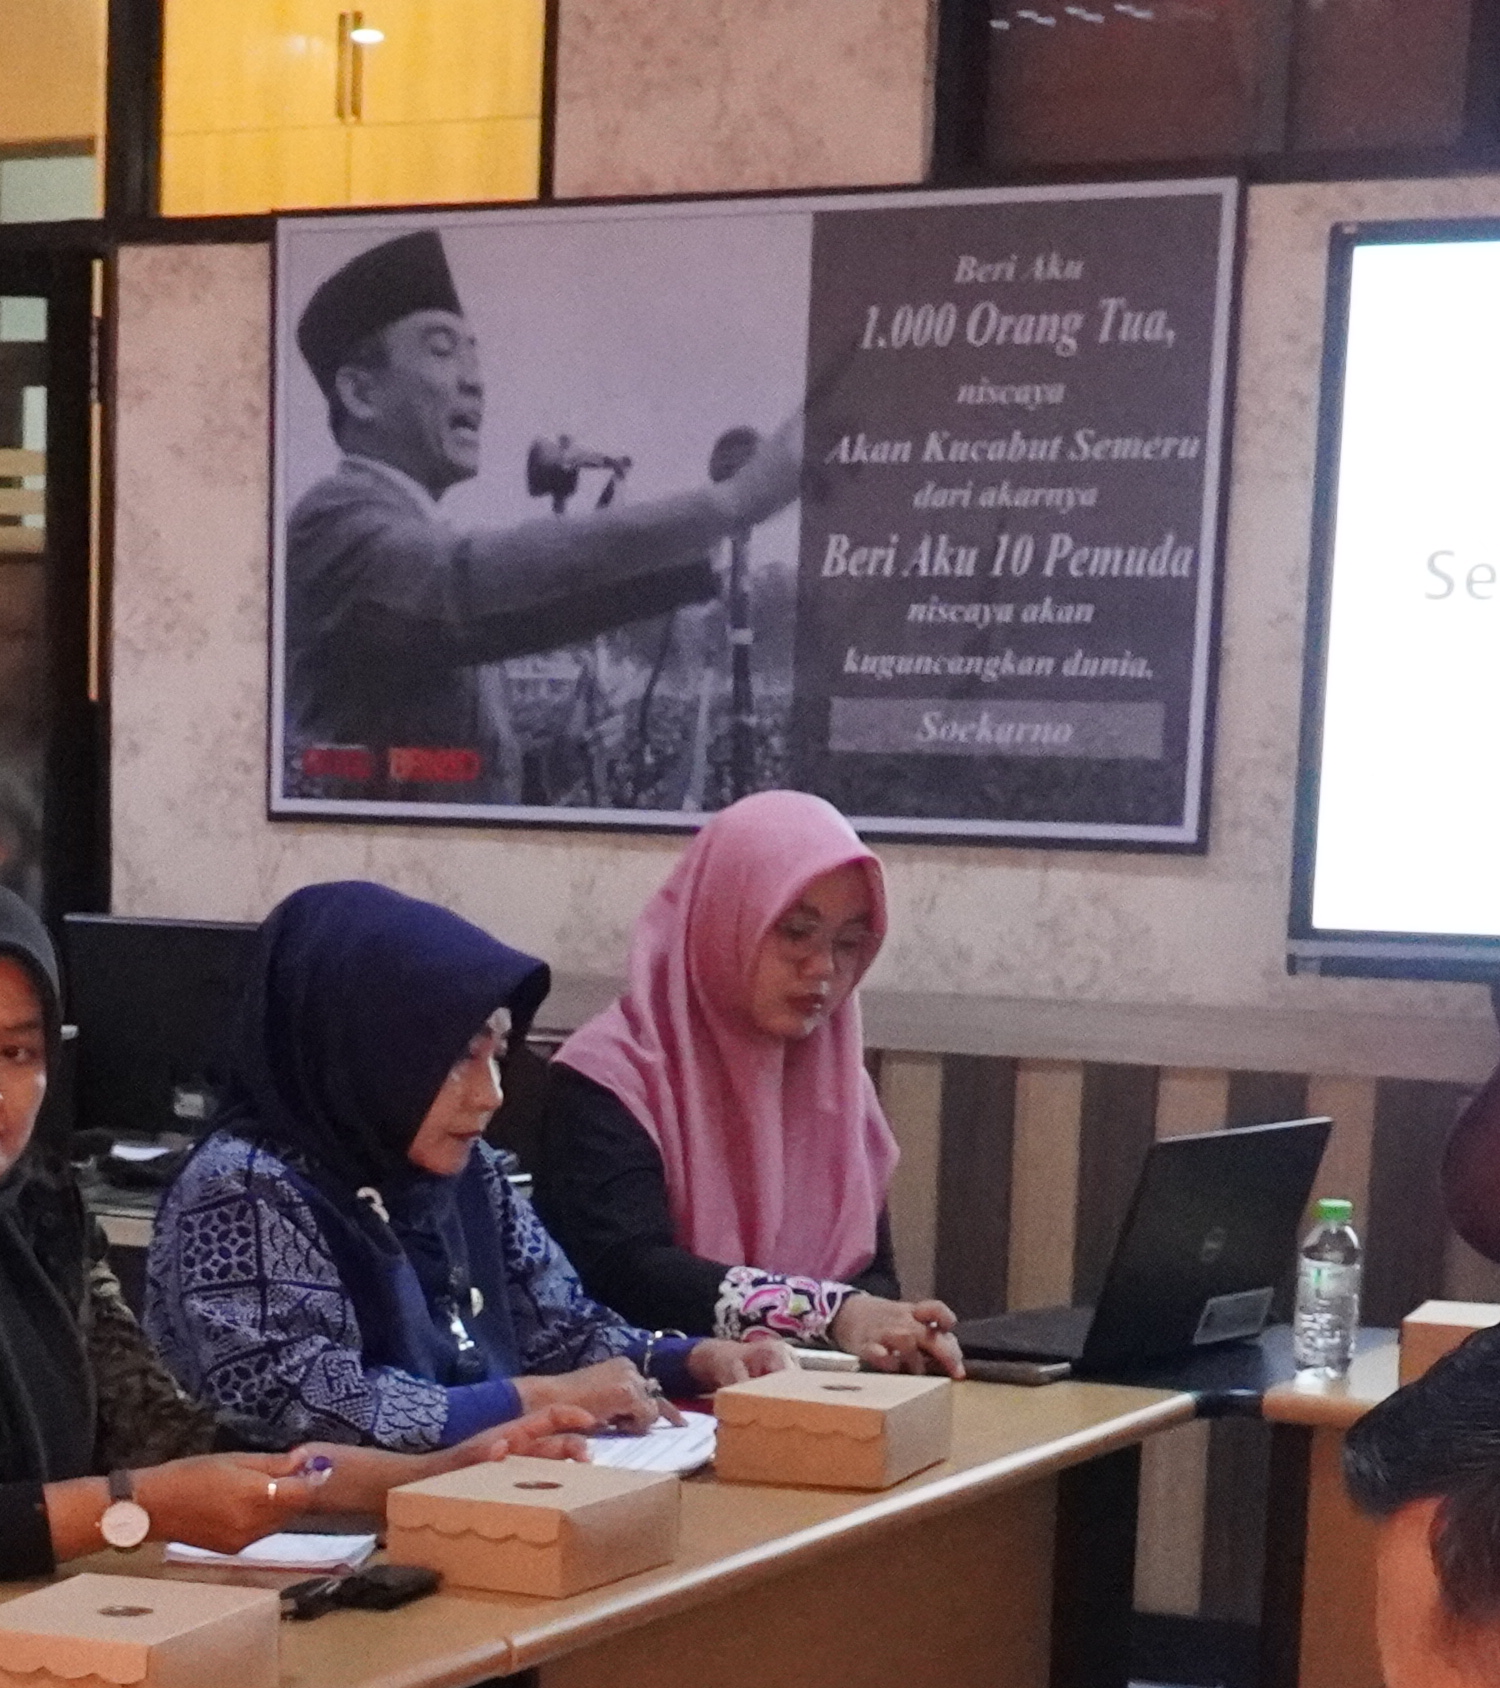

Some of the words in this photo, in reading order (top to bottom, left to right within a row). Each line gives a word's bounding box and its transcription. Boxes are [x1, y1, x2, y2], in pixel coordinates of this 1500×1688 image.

[954, 254, 1018, 284] Beri
[1029, 251, 1085, 283] Aku
[860, 303, 959, 350] 1.000
[965, 301, 1086, 357] Orang
[1097, 297, 1177, 348] Tua,
[955, 376, 1066, 411] niscaya
[824, 431, 913, 464] Akan
[920, 430, 1063, 463] Kucabut
[1067, 428, 1201, 462] Semeru
[912, 480, 973, 511] dari
[976, 480, 1099, 515] akarnya
[819, 532, 899, 579] Beri
[902, 532, 980, 578] Aku
[991, 533, 1036, 577] 10
[1043, 531, 1191, 579] Pemuda
[906, 595, 1016, 629] niscaya
[1019, 595, 1095, 624] akan
[842, 645, 1056, 681] kuguncangkan
[919, 711, 1075, 747] Soekarno
